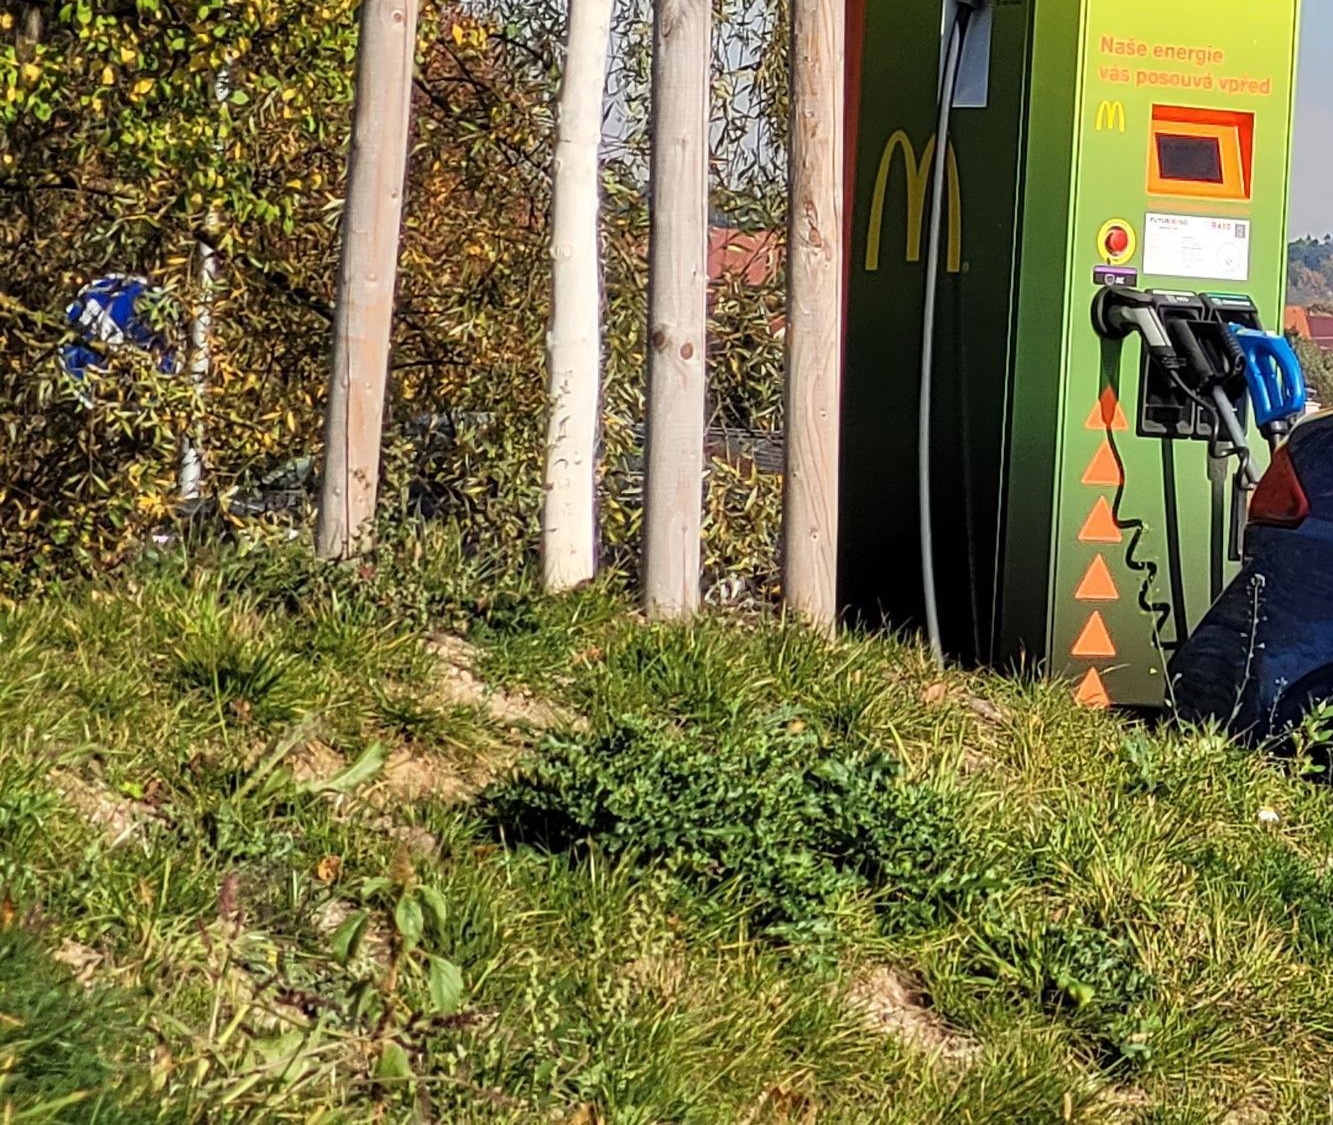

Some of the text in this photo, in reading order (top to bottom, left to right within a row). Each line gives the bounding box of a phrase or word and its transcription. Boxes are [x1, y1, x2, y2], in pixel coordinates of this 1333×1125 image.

[1100, 36, 1224, 66] Naše energie
[1099, 63, 1271, 95] vás posouvá vpřed
